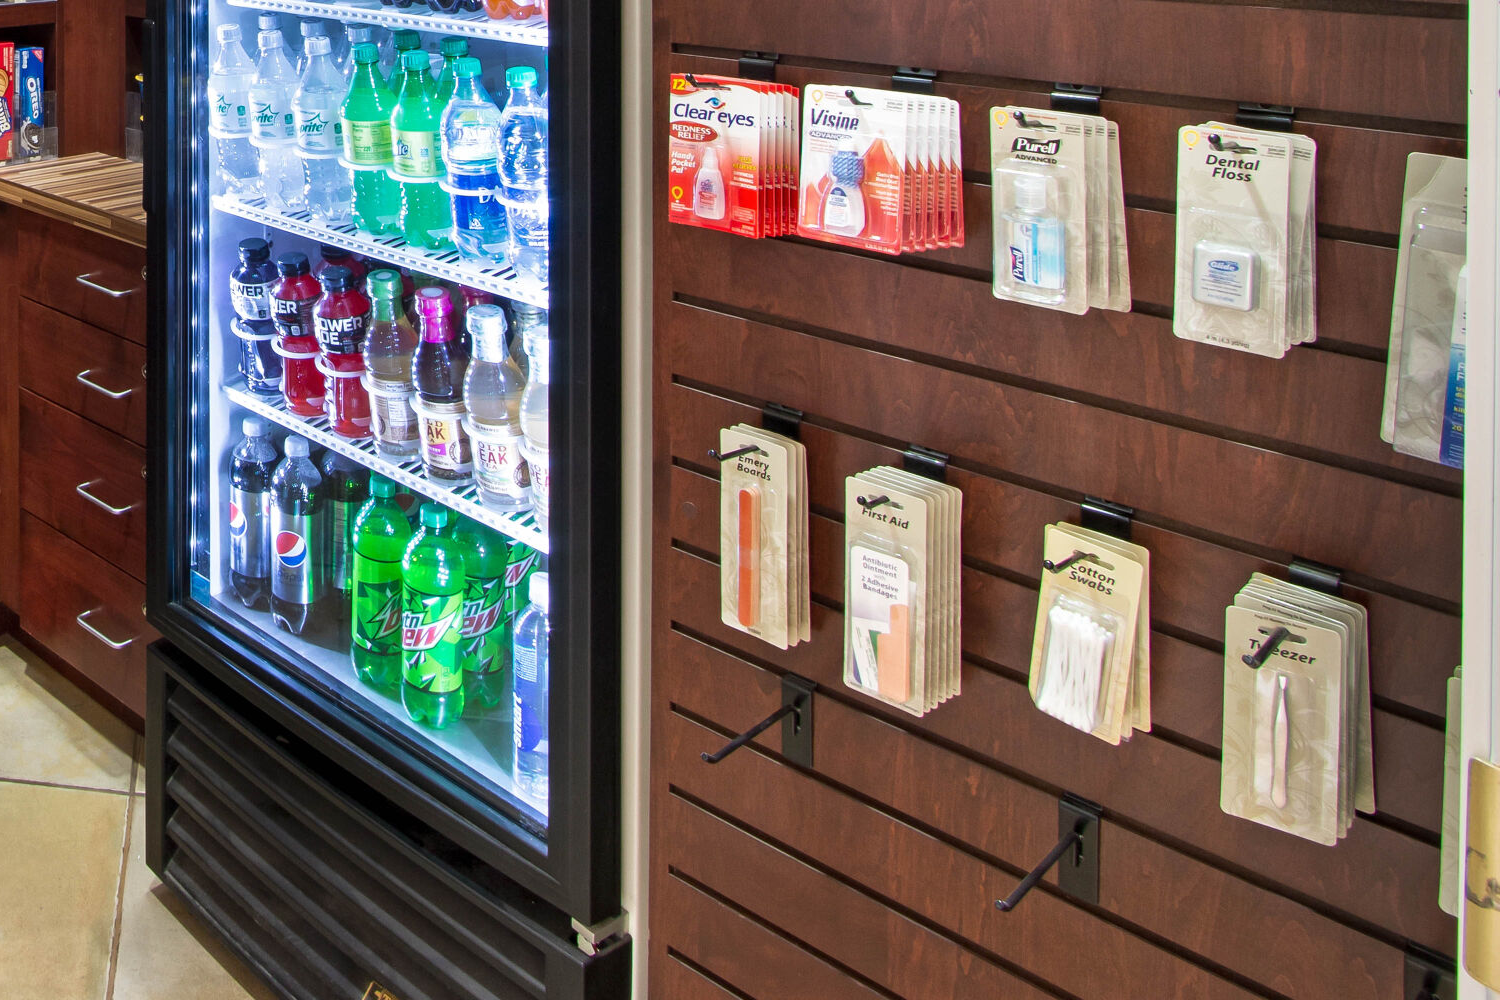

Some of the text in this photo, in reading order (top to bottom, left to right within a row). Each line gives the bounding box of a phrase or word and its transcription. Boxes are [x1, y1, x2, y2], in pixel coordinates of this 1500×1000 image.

[671, 78, 686, 91] 12
[26, 76, 39, 119] OREO
[673, 103, 755, 128] Clear eyes
[811, 107, 860, 131] Visine
[671, 123, 712, 136] REDNESS
[677, 131, 706, 141] RELIEF
[1016, 137, 1058, 155] Purell
[671, 151, 695, 162] Handy
[671, 158, 696, 168] Pocket
[1014, 153, 1058, 165] ADVANCED
[1205, 154, 1261, 171] Dental
[670, 165, 684, 174] Pal
[1211, 167, 1253, 183] Floss
[1012, 250, 1024, 282] Purell
[316, 318, 362, 334] OWER
[426, 422, 445, 440] AK
[477, 441, 508, 453] OLD
[479, 446, 508, 465] EAK
[736, 463, 772, 482] Boards
[738, 455, 770, 473] Emery
[861, 508, 910, 530] First Aid
[862, 554, 898, 571] Antibiotic
[862, 562, 897, 579] Ointment
[862, 582, 898, 600] Bandages
[867, 577, 899, 593] Adhesive
[1069, 570, 1113, 596] Swabs
[462, 598, 481, 616] tn
[462, 609, 502, 638] ew
[402, 626, 442, 648] ew
[1249, 638, 1317, 665] Teezer
